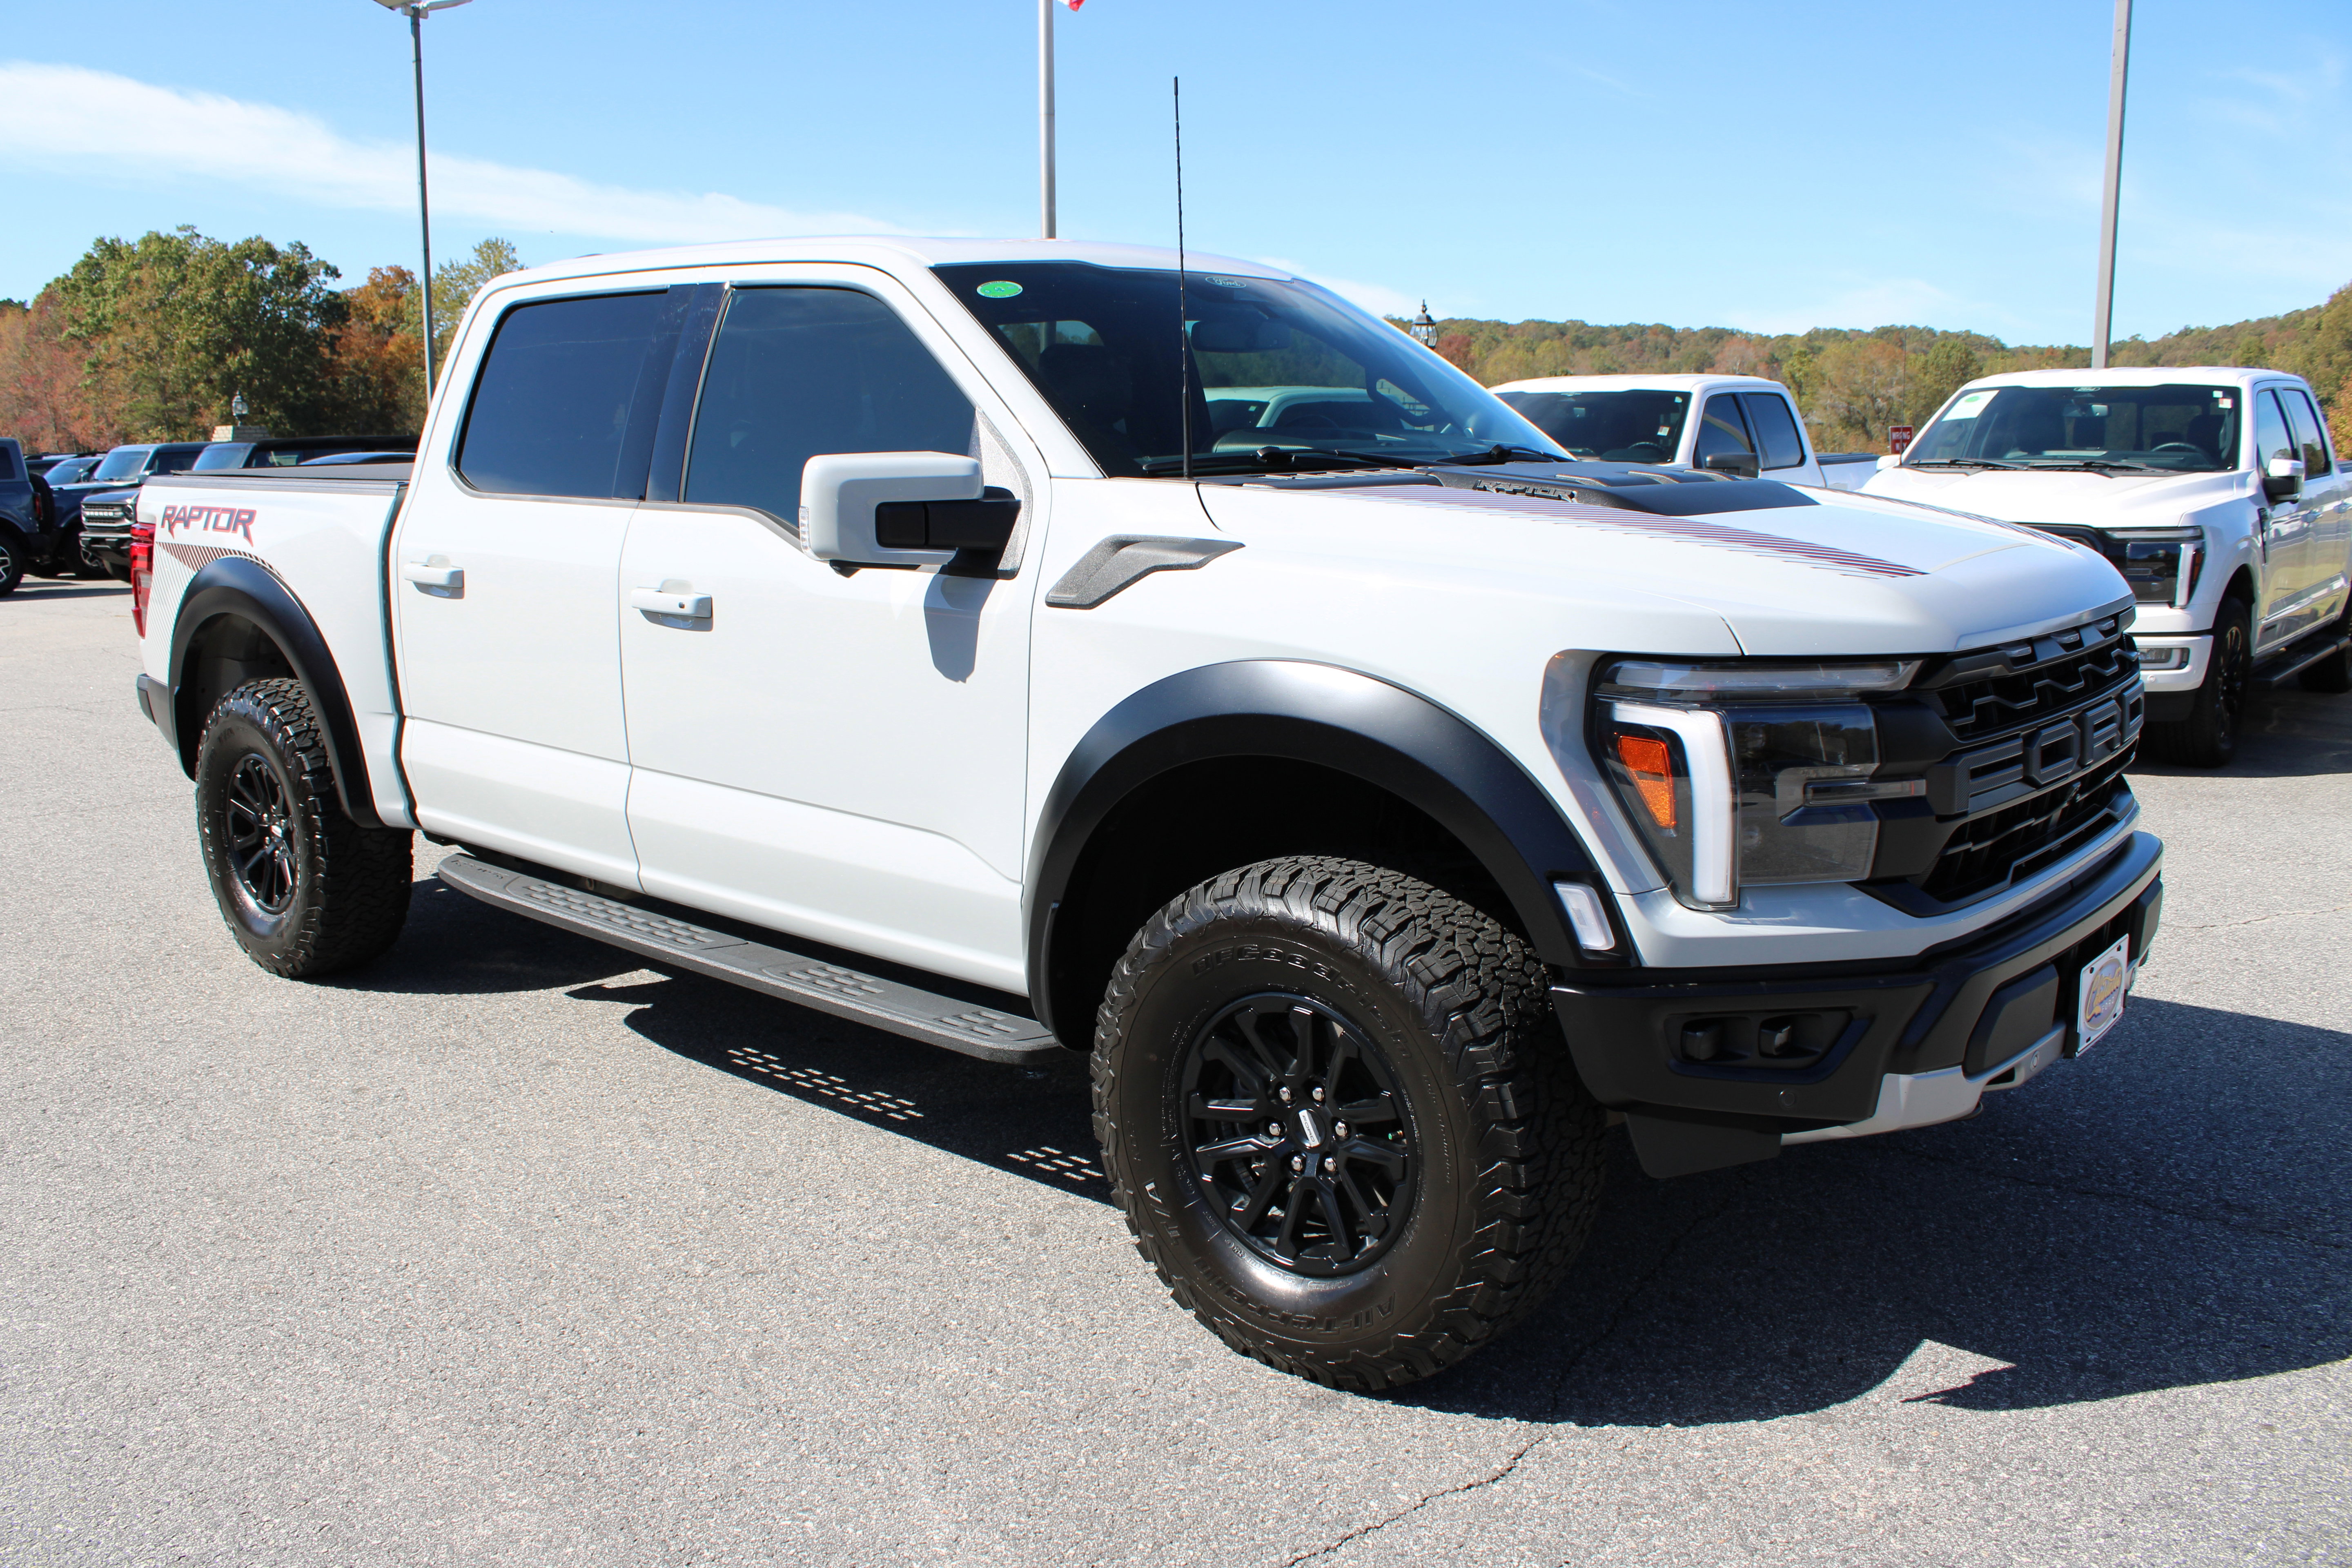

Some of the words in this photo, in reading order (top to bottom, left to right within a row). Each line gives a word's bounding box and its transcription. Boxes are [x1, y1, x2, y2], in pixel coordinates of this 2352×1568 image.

[1892, 431, 1910, 440] WRONG
[1895, 443, 1907, 451] WY
[1472, 479, 1577, 503] RAPTOR
[161, 505, 257, 547] RAPTOR
[1954, 679, 2145, 813] FORD
[1190, 944, 1412, 1059] BFGoodrich
[1302, 1115, 1315, 1143] FORD
[1143, 1178, 1181, 1246] T/A
